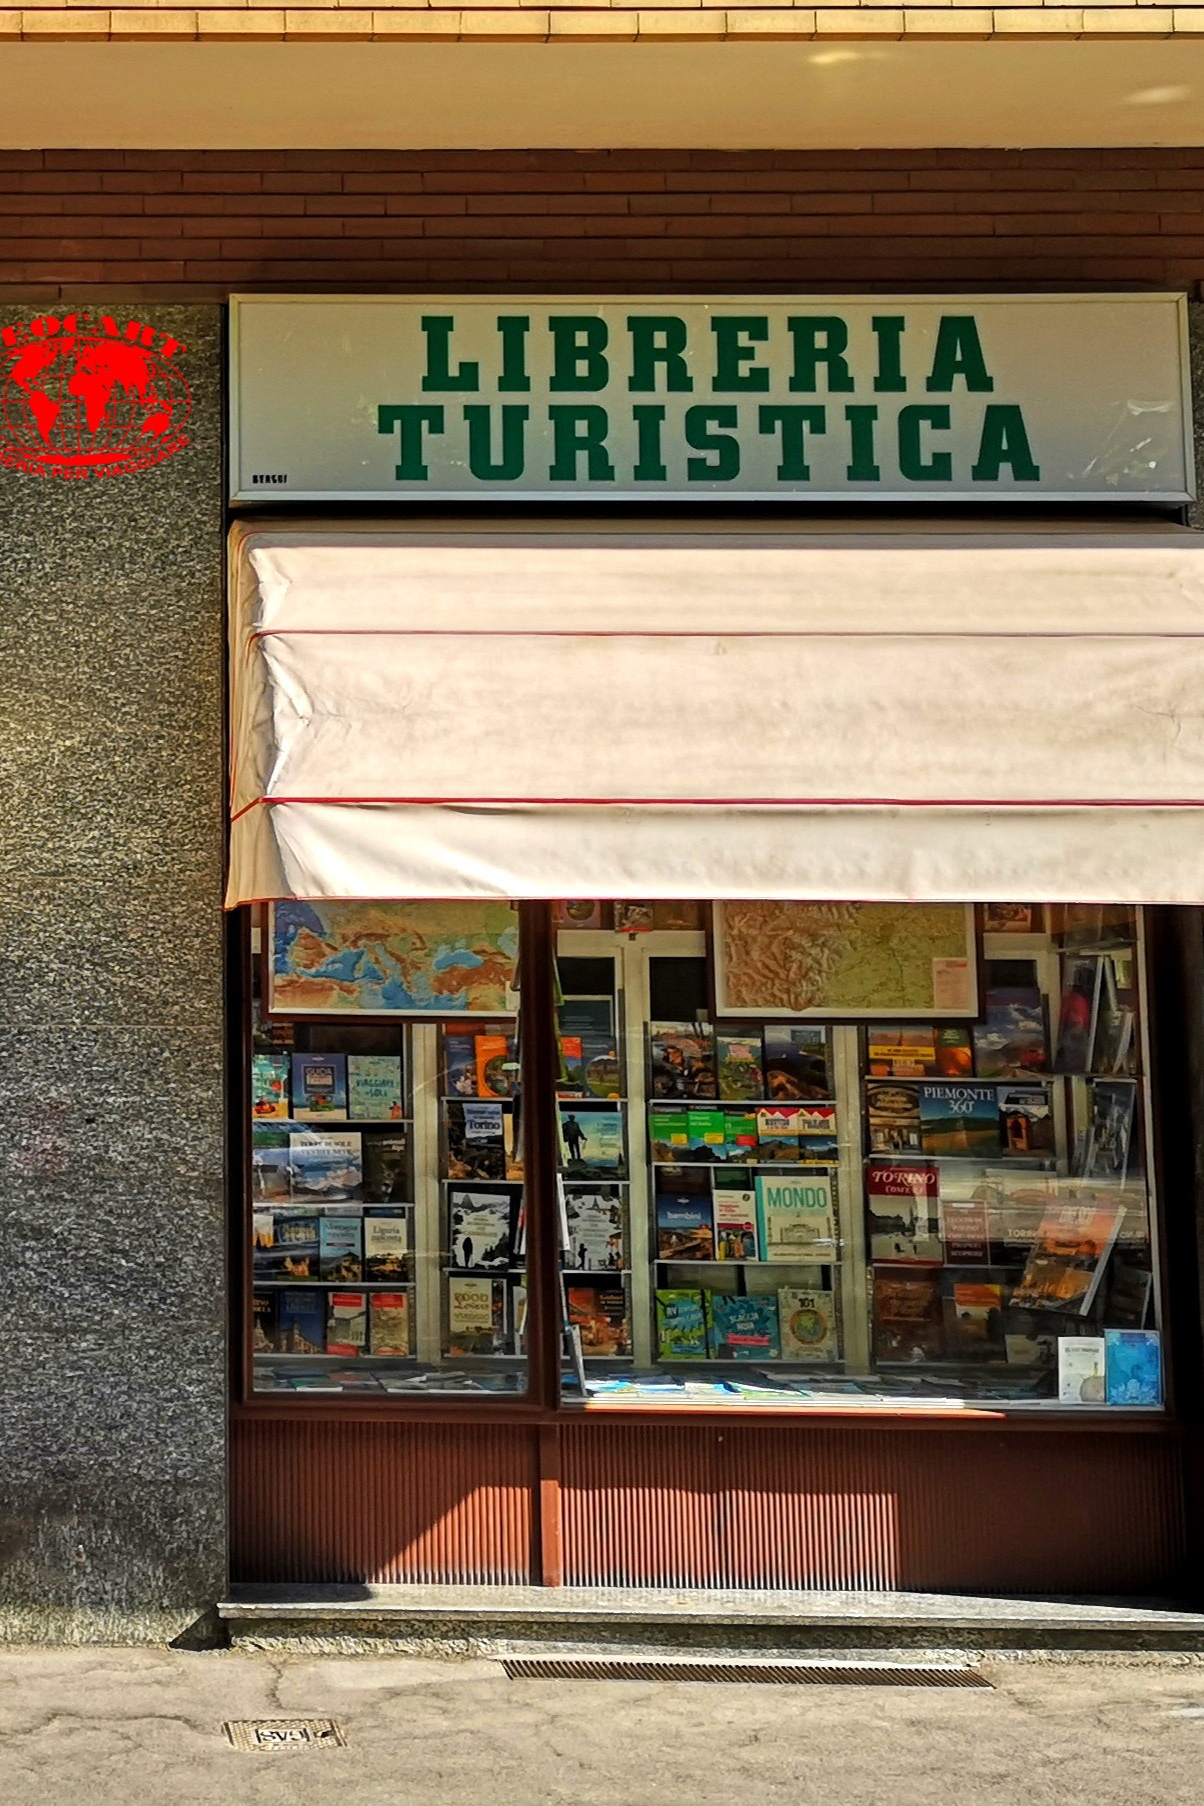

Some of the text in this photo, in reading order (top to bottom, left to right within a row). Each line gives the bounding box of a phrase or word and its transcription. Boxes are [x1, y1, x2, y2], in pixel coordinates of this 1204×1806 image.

[421, 316, 993, 392] LIBRERIA
[378, 405, 1040, 481] TURISTICA
[51, 467, 89, 480] PER
[95, 432, 191, 479] VIAGGIARE
[923, 1086, 995, 1101] PIEMONTE
[469, 1120, 501, 1130] Torino
[872, 1170, 936, 1187] TORINO
[767, 1187, 829, 1208] MONDO
[666, 1211, 702, 1220] bambini
